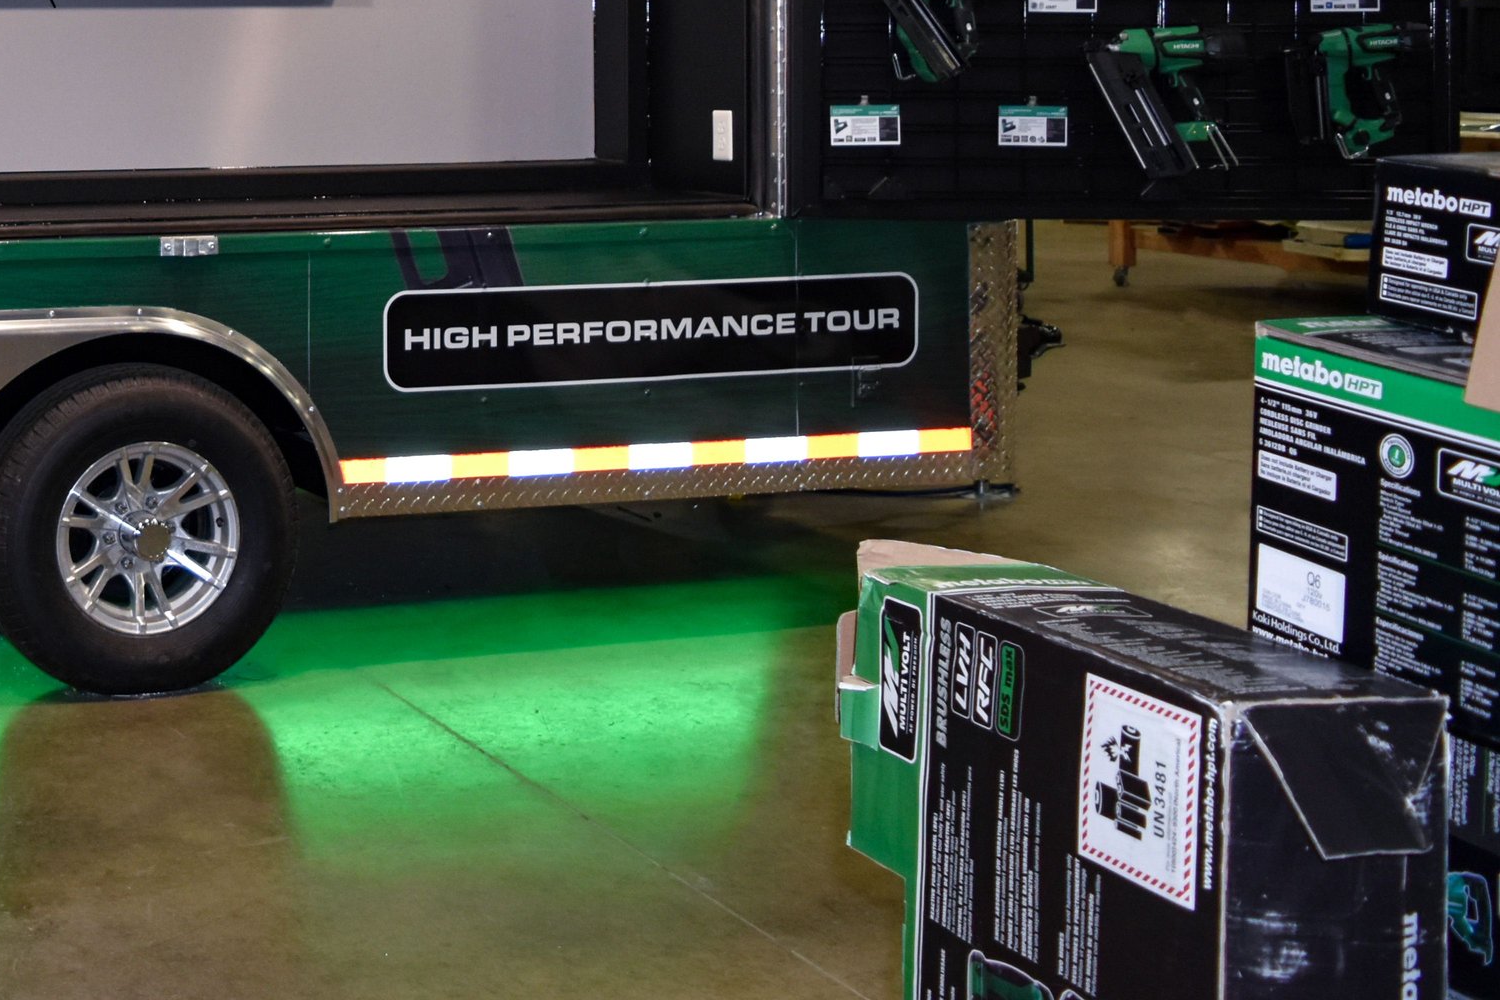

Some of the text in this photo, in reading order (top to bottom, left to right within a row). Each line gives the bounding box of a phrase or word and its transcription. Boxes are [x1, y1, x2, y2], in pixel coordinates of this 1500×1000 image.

[1387, 186, 1491, 217] metabo HPT
[1478, 246, 1496, 254] MULT
[403, 307, 900, 351] HIGH PERFORMANCE TOUR
[1261, 351, 1381, 397] metabo HPT
[1453, 478, 1500, 497] MULTI VOL
[1307, 571, 1321, 589] Q6
[1252, 610, 1270, 626] Koki
[1271, 616, 1307, 642] Holdings
[899, 631, 911, 731] MULTI VOLT
[936, 616, 952, 748] BRUSHLESS
[955, 631, 971, 710] LVH
[976, 637, 993, 723] RFC
[999, 650, 1015, 730] SDS max
[1203, 718, 1218, 890] www.metabo-hpt.com
